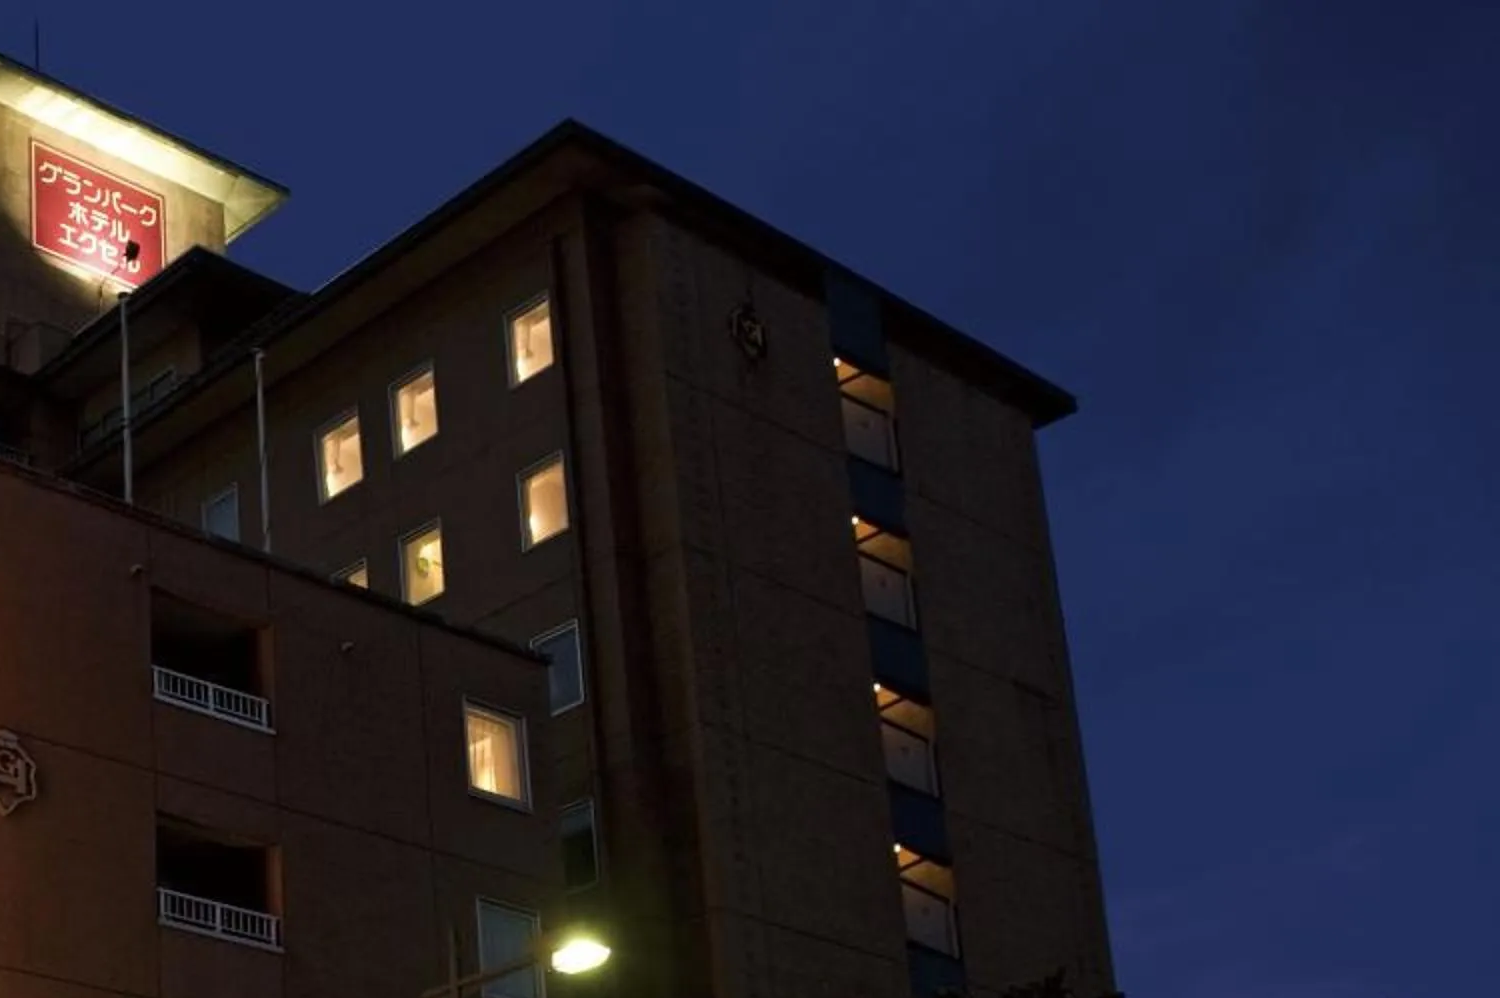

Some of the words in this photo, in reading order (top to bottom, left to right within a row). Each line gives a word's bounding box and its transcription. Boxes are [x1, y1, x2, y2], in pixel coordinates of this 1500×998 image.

[38, 161, 157, 226] グランパーク
[67, 202, 131, 243] ホテル
